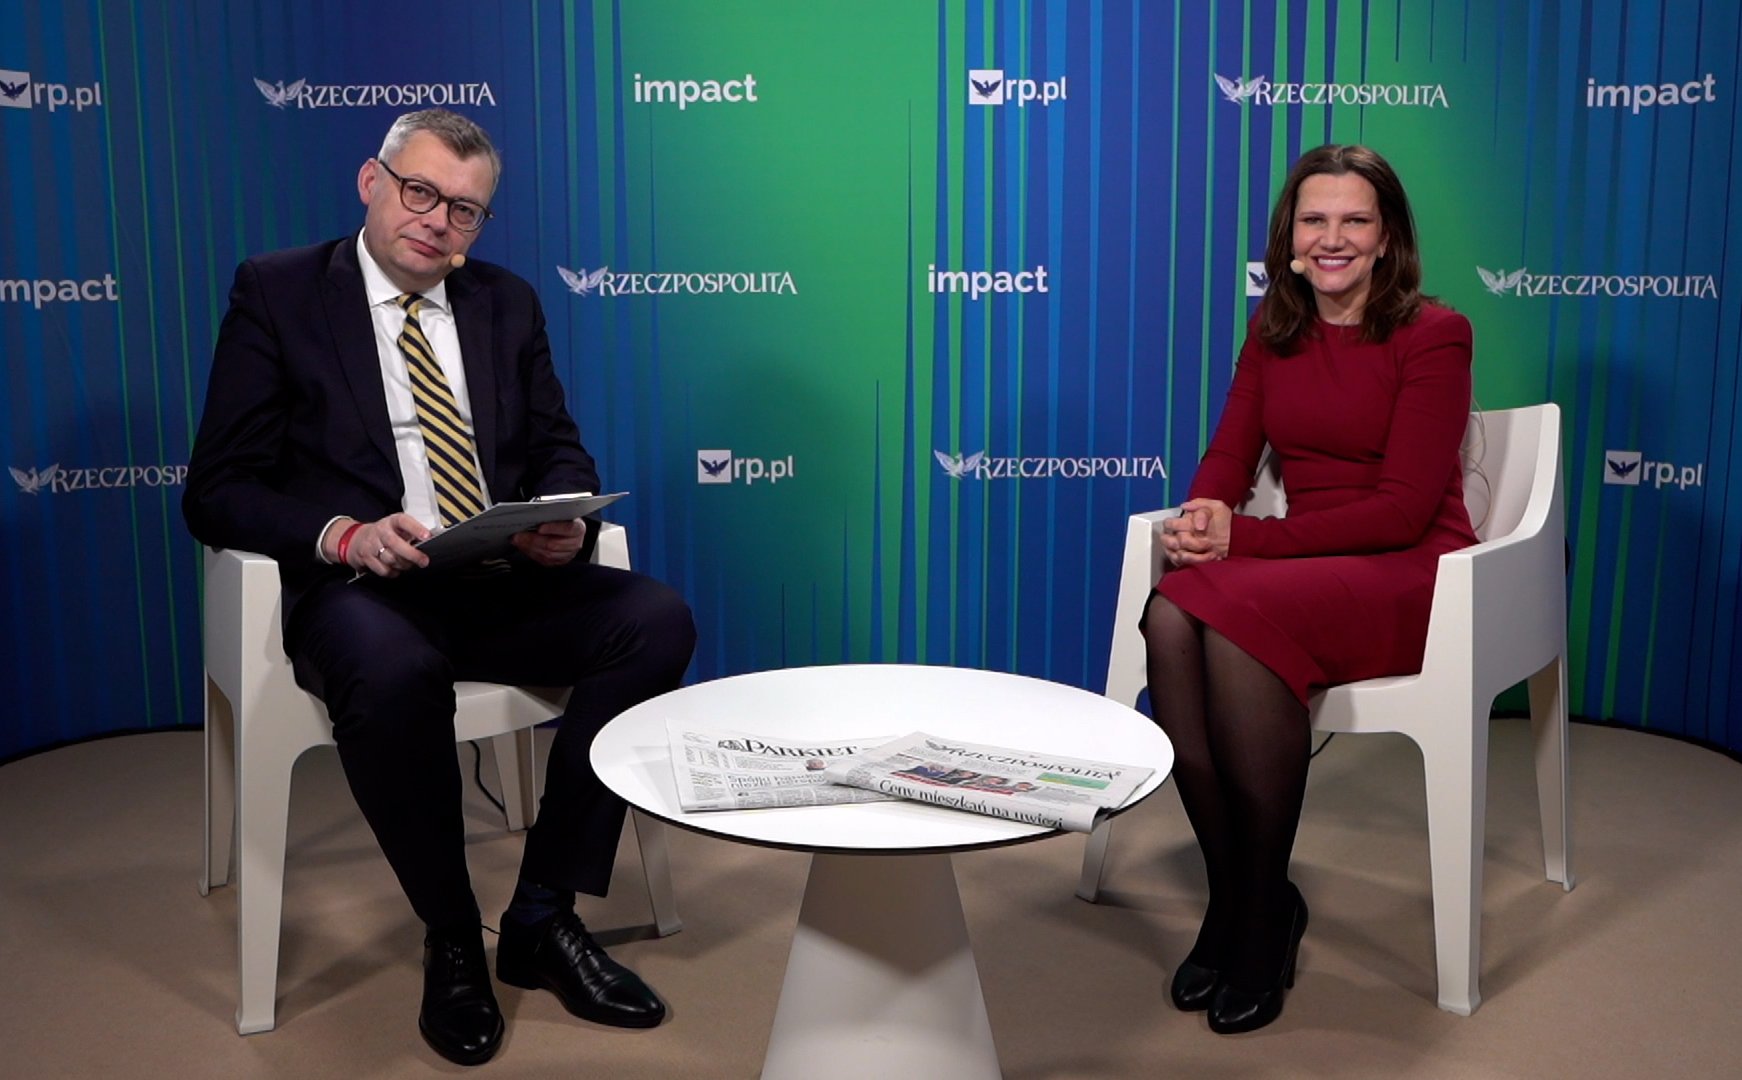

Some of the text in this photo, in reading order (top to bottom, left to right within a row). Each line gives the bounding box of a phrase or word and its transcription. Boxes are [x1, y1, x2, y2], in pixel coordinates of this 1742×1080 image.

[34, 81, 102, 112] rp.pl
[298, 82, 497, 110] RZECZPOSPOLITA
[633, 73, 758, 110] impact
[1005, 76, 1068, 107] rp.pl
[1255, 82, 1449, 108] RZECZPOSPOLITA
[1586, 73, 1716, 115] impact
[600, 271, 798, 297] RZECZPOSPOLITA
[927, 264, 1049, 300] impact
[1516, 272, 1719, 299] RZECZPOSPOLITA
[734, 455, 794, 485] rp.pl
[975, 455, 1168, 481] RZECZPOSPOLITA
[1643, 460, 1703, 491] rp.pl
[743, 738, 857, 757] PARKIET
[950, 747, 1116, 780] RZECZPOSPOLITA
[880, 779, 916, 797] Ceny
[919, 789, 988, 813] mieszkań
[991, 806, 1010, 819] na
